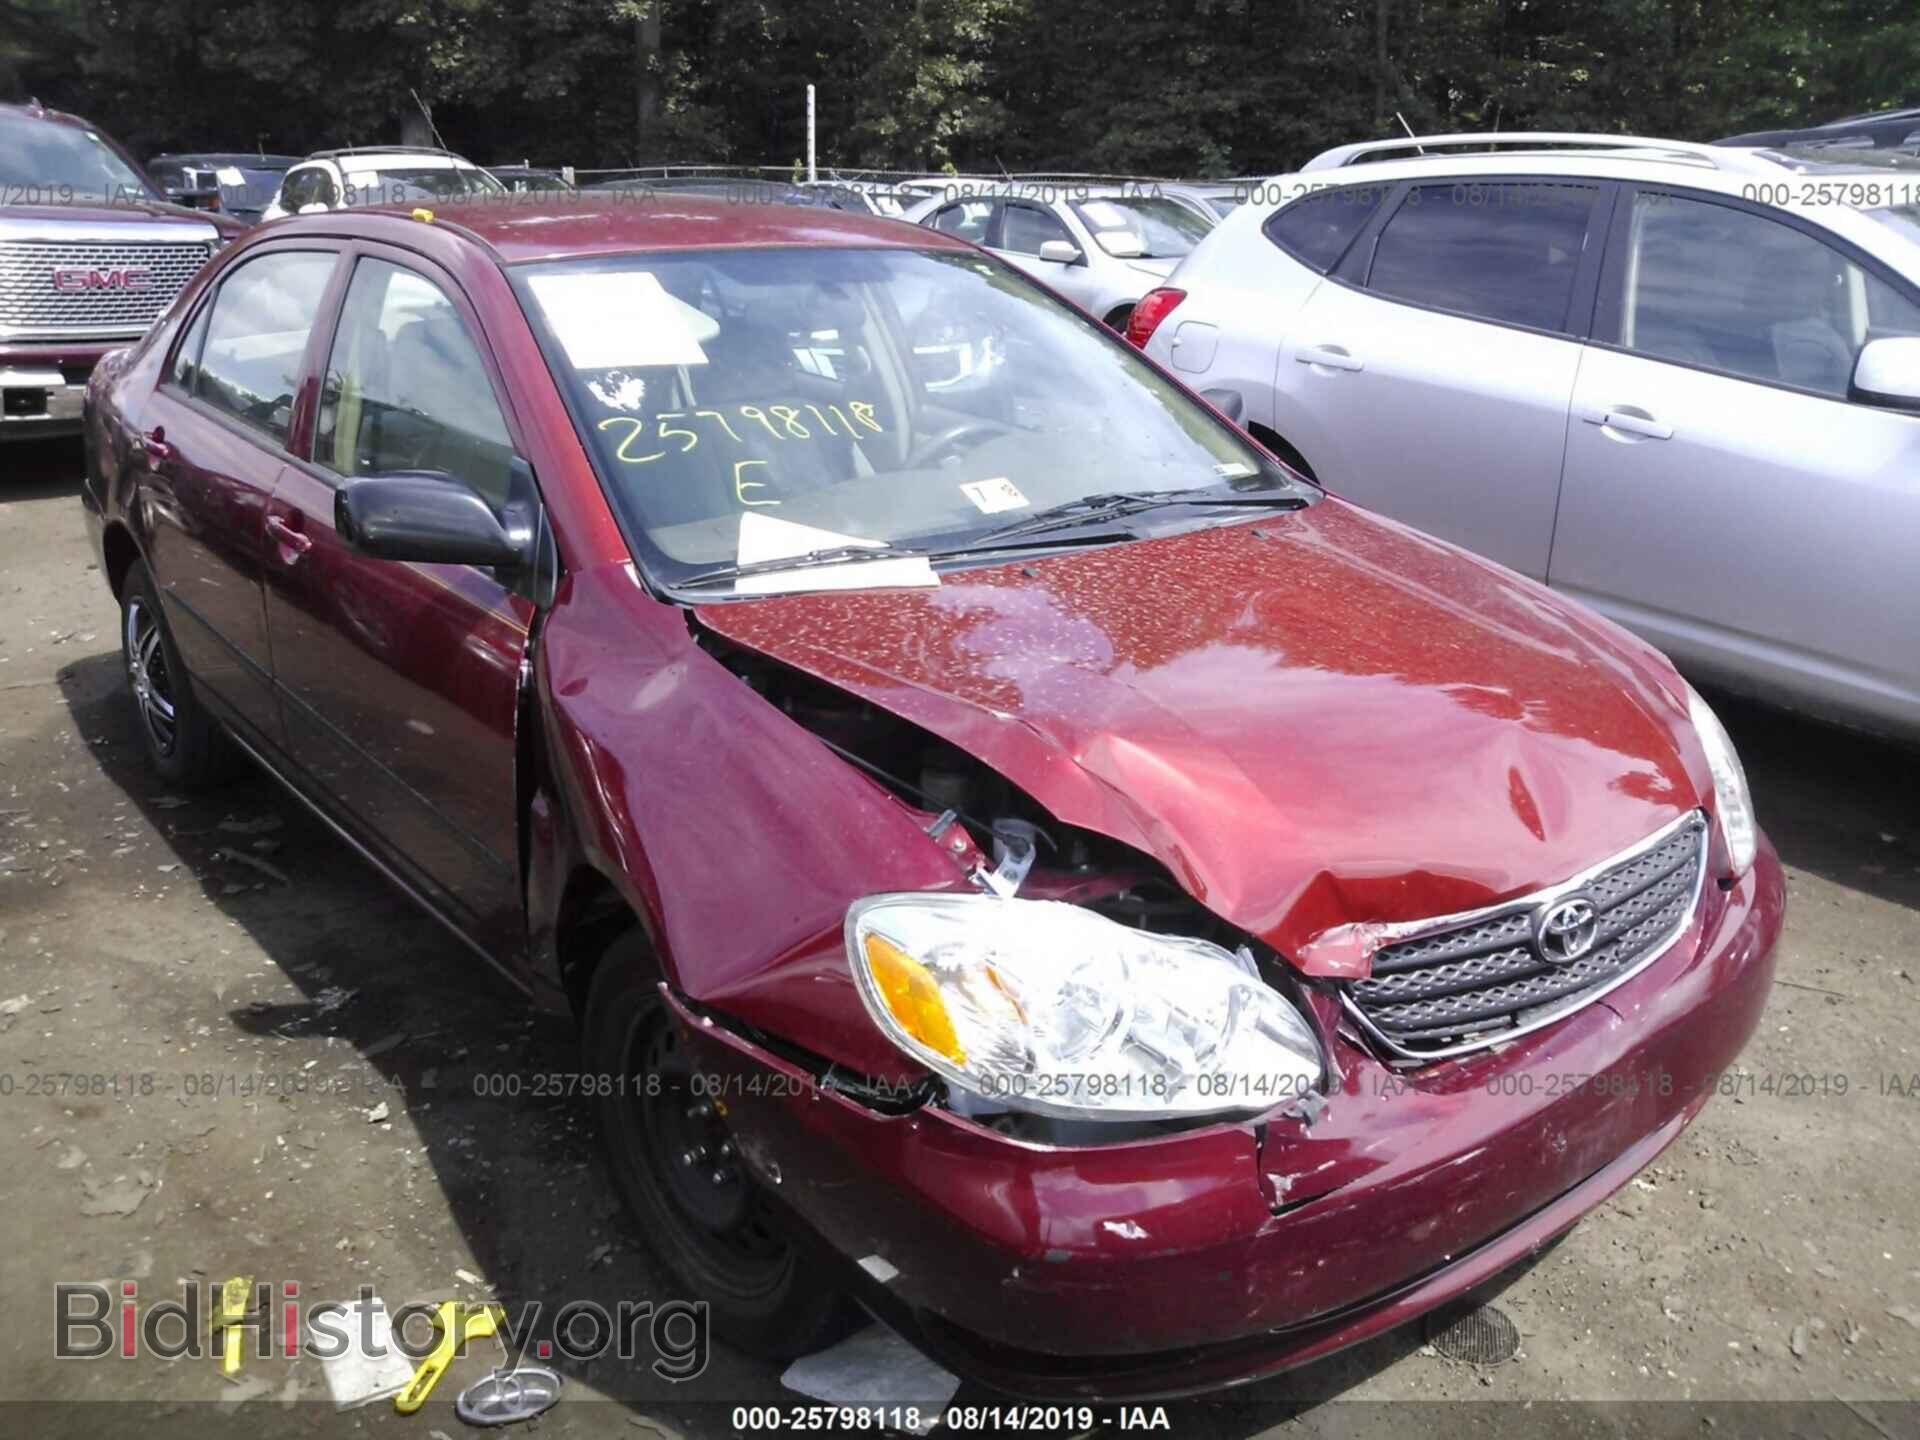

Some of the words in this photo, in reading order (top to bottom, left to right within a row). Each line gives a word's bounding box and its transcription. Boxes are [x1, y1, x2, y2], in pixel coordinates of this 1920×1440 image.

[54, 268, 152, 290] GMC
[598, 400, 883, 463] 25798118
[735, 460, 781, 505] E
